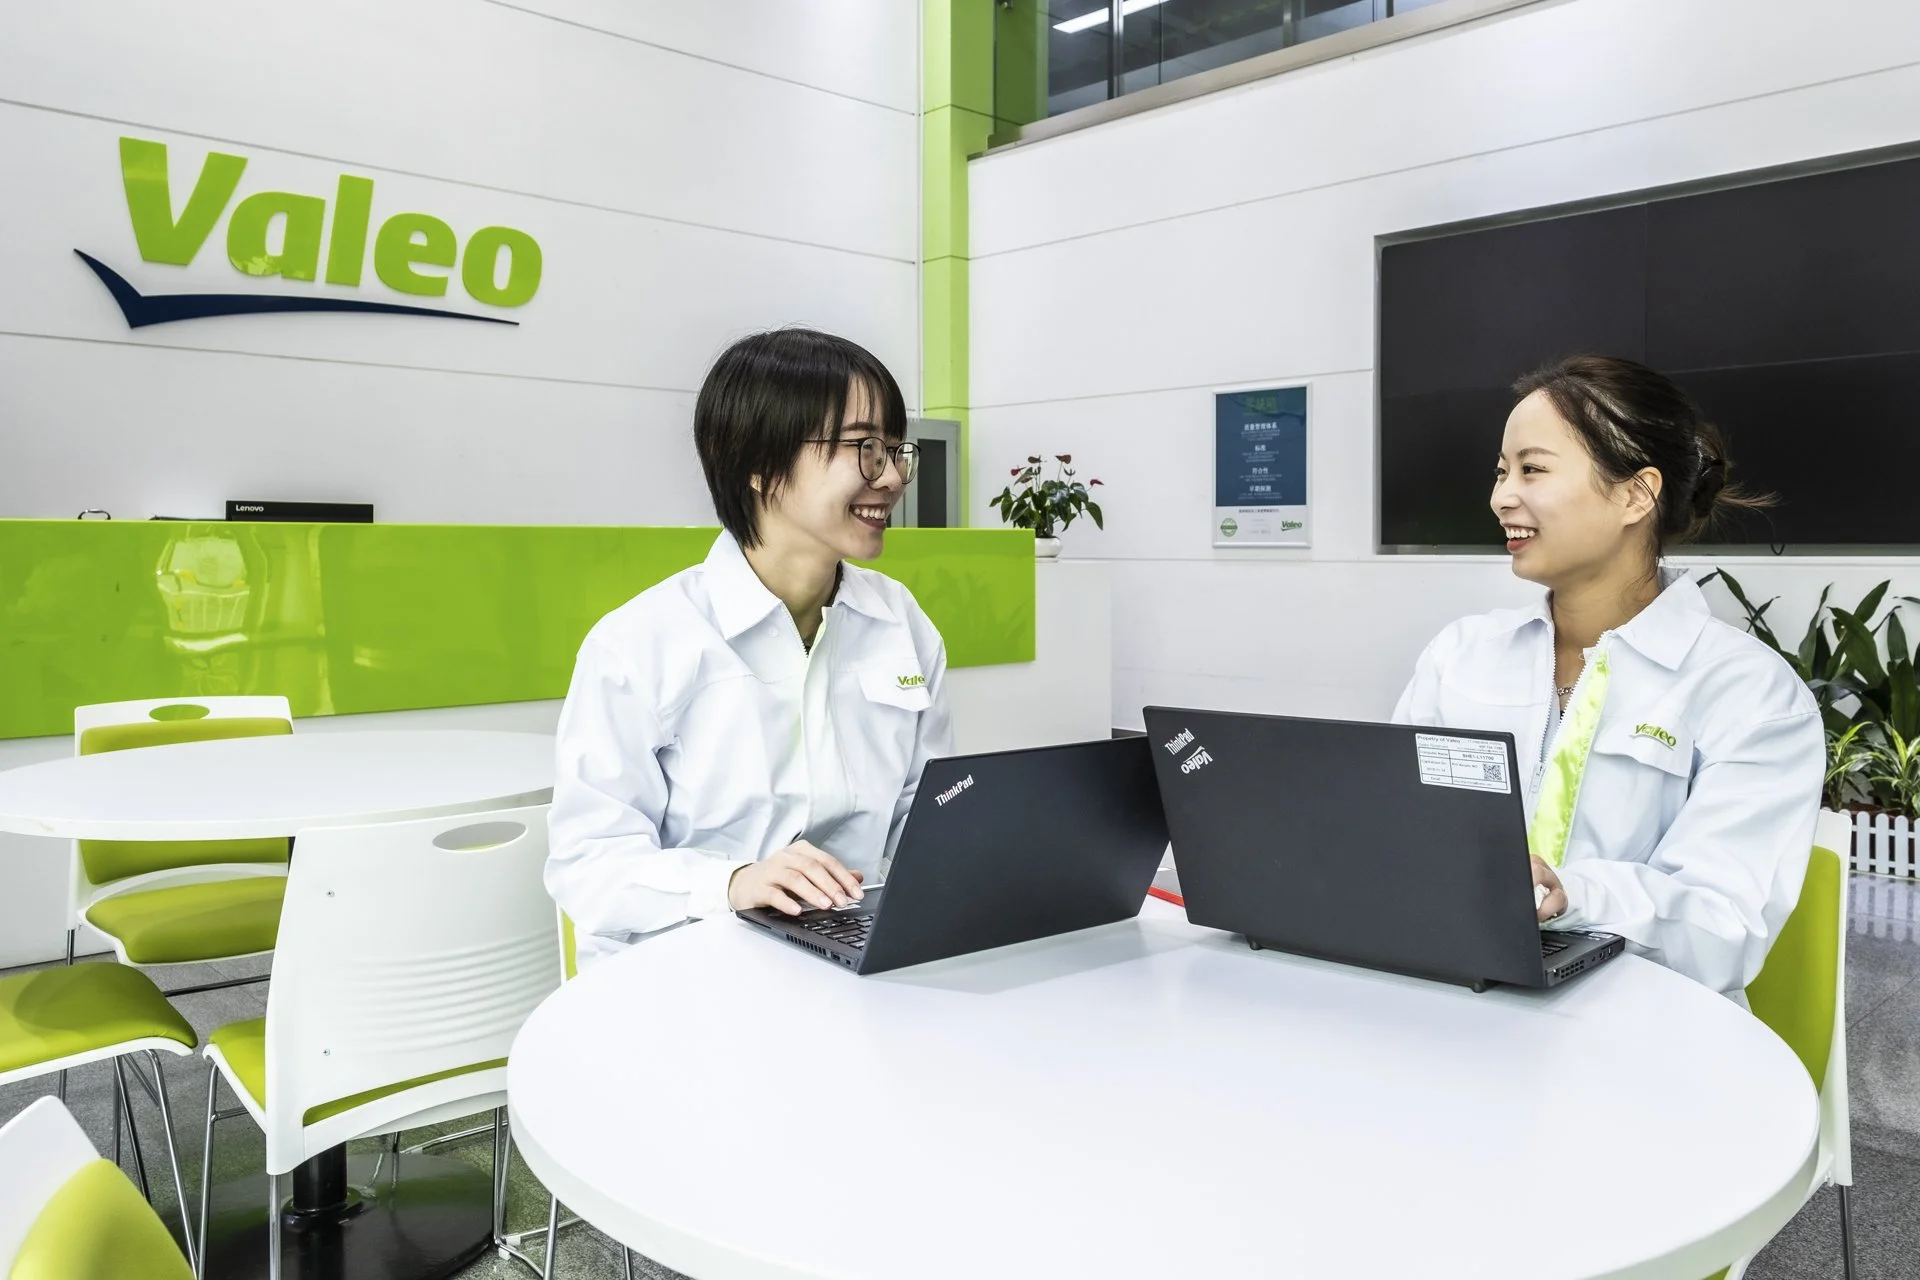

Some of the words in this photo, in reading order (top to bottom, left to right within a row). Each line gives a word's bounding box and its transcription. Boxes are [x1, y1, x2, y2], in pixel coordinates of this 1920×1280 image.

[119, 136, 543, 308] Valeo
[235, 504, 264, 512] Lenovo
[1281, 520, 1303, 529] Valeo
[897, 675, 926, 686] Vale
[1164, 727, 1195, 755] ThinkPad
[1635, 723, 1677, 747] Valeo
[1181, 750, 1213, 774] Valeo
[934, 774, 974, 806] ThinkPad
